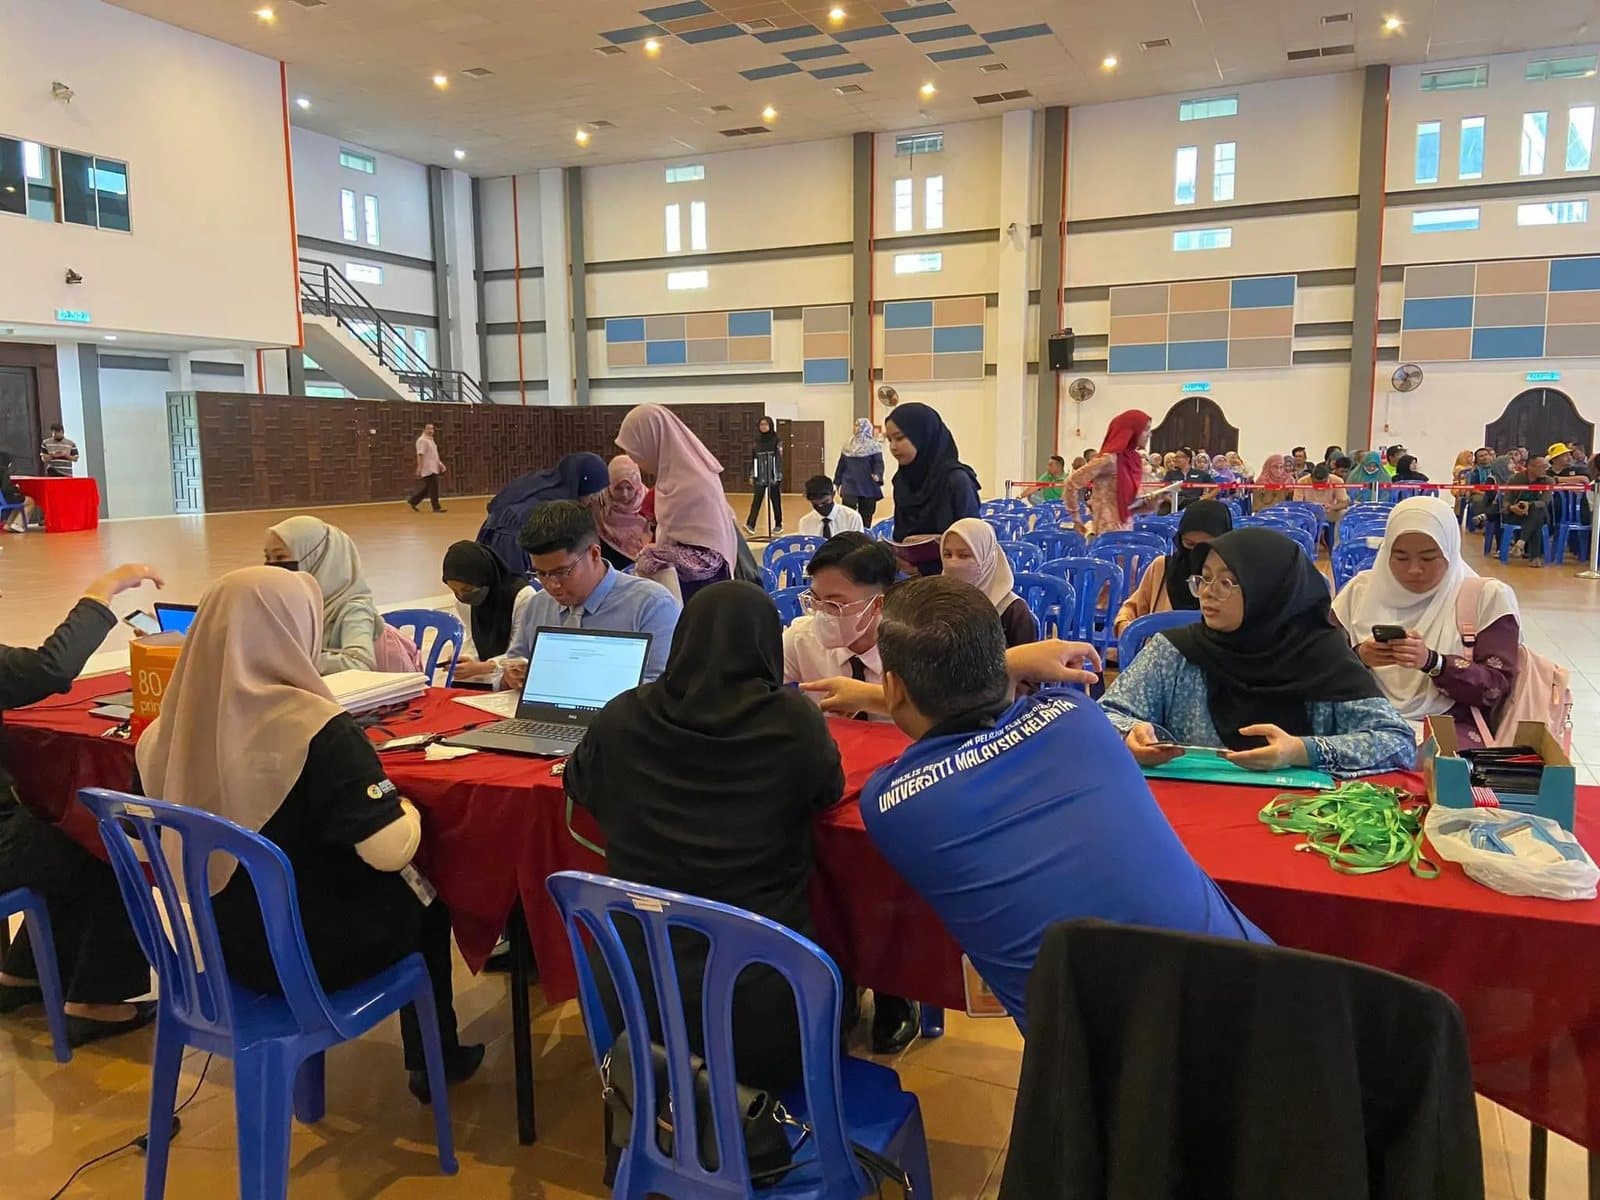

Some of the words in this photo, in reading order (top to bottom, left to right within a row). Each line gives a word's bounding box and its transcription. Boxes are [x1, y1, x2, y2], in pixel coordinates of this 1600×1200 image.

[139, 670, 162, 696] 80
[878, 756, 954, 813] UNIVERSITI
[954, 730, 1025, 771] MALAYSIA
